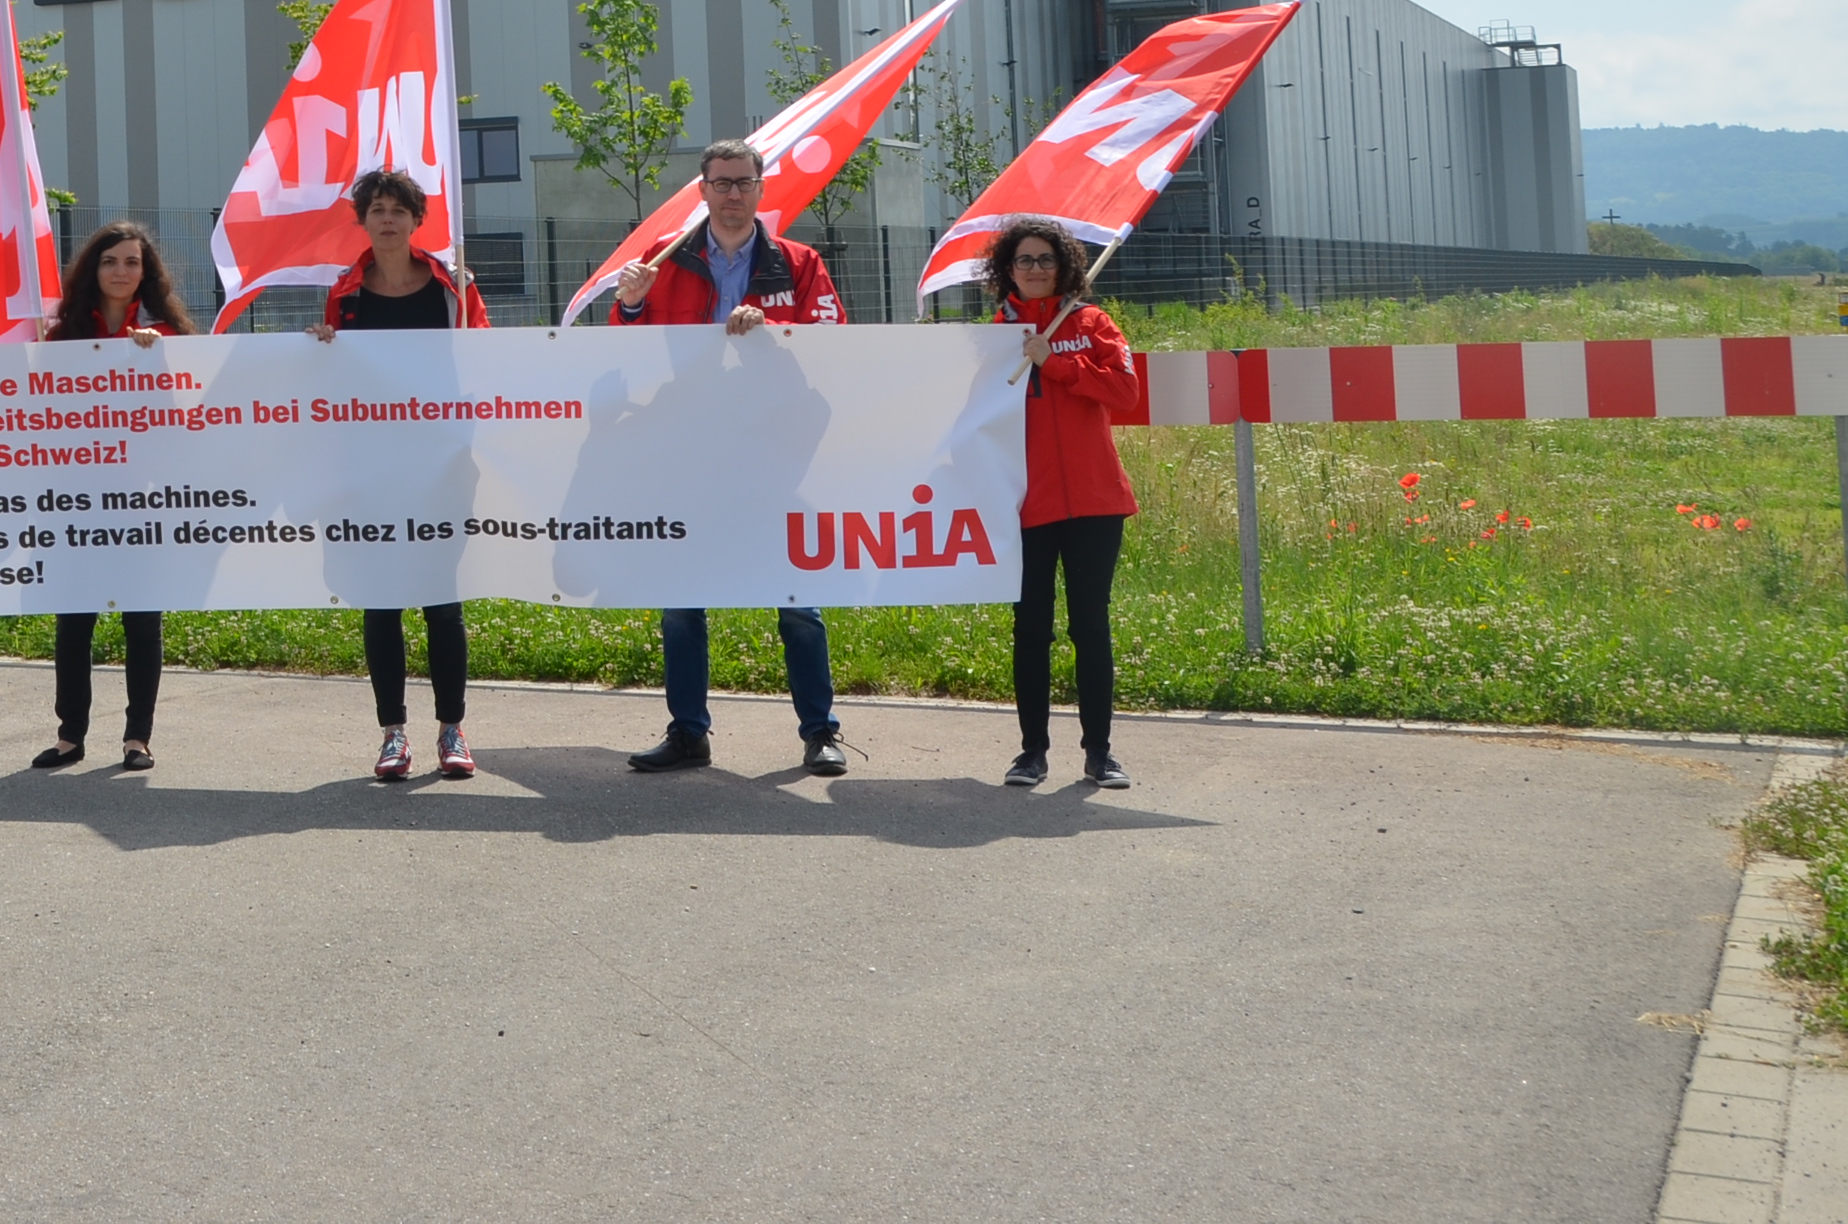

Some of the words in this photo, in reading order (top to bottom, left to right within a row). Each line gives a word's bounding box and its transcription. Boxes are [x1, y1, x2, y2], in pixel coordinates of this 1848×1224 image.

[28, 368, 203, 395] Maschinen.
[253, 399, 300, 424] bei
[311, 395, 583, 423] Subunternehmen
[36, 489, 92, 512] des
[101, 485, 256, 510] machines.
[18, 525, 56, 548] de
[65, 521, 163, 547] travail
[173, 519, 316, 544] décentes
[325, 518, 396, 542] chez
[407, 518, 454, 542] les
[464, 516, 687, 541] sous-traitants
